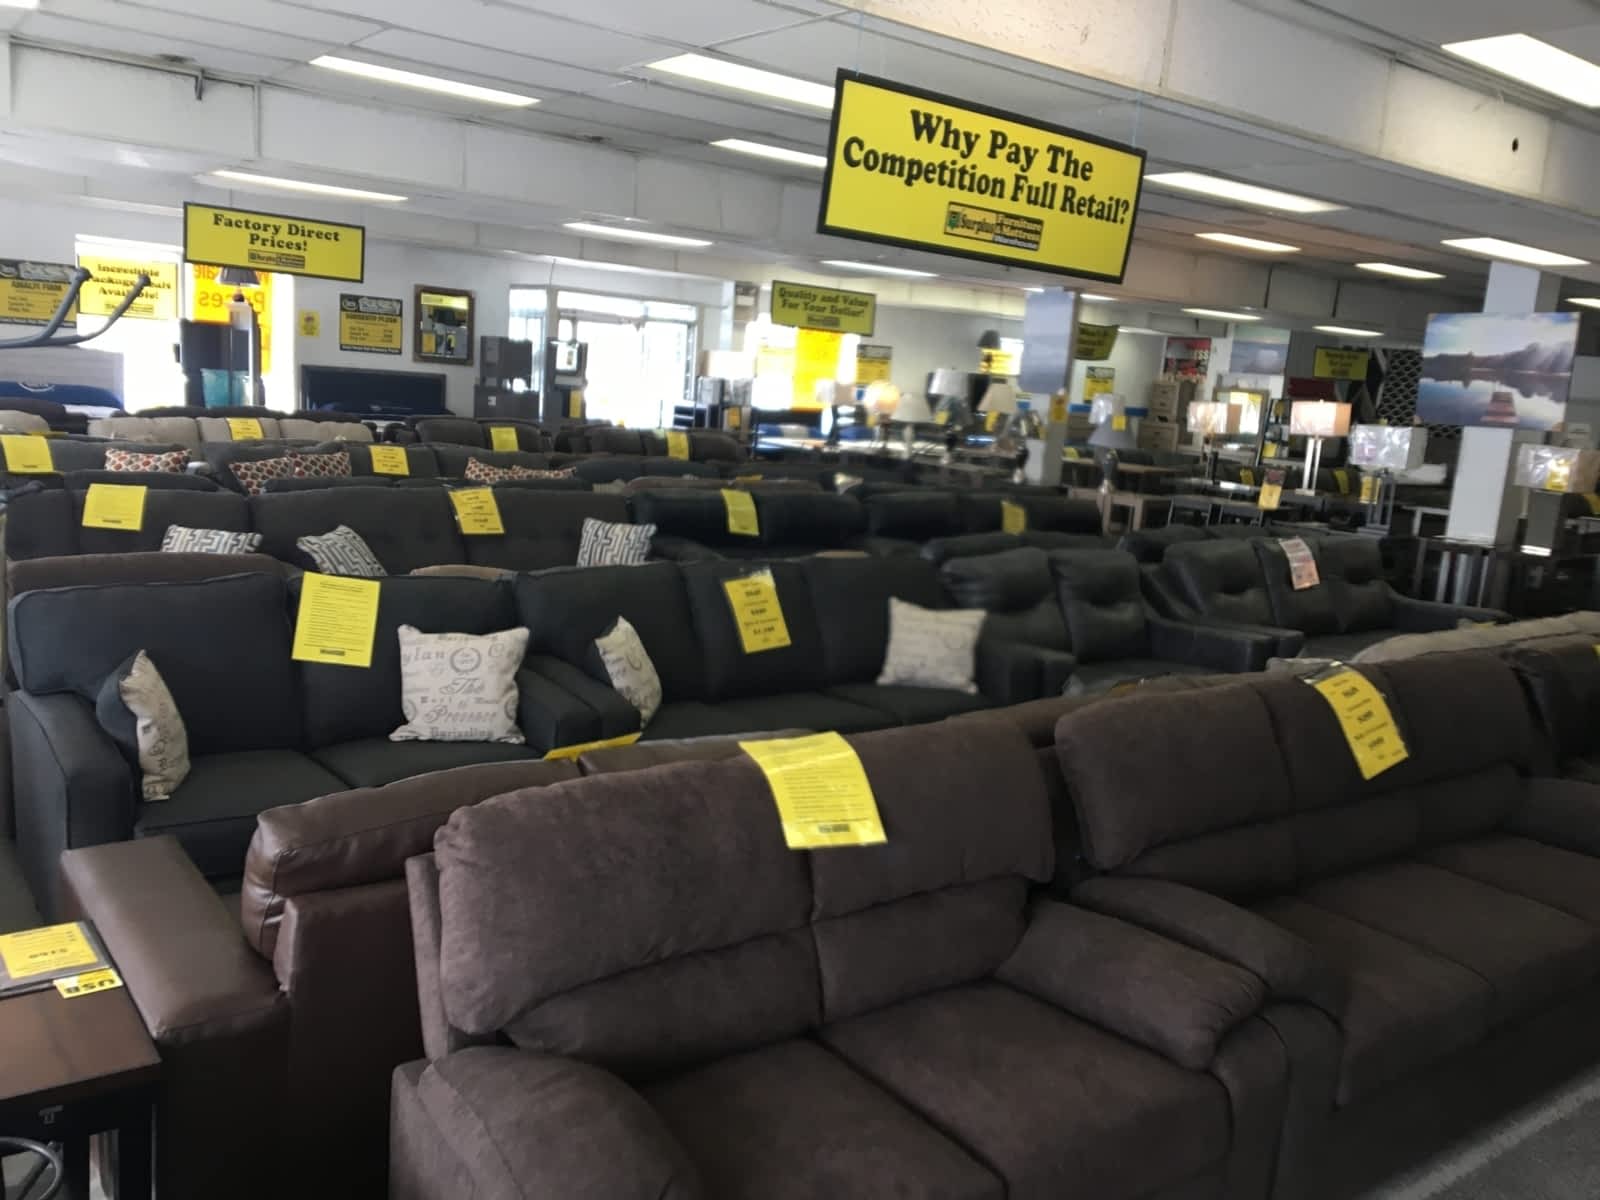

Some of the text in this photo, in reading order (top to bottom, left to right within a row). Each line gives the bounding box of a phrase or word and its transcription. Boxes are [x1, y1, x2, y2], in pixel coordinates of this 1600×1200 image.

[910, 109, 1093, 181] Why Pay The
[843, 136, 1130, 224] Competition Full Retail?
[212, 213, 341, 242] Factory Direct
[249, 233, 308, 251] Prices!
[779, 287, 869, 307] Quality and Value
[782, 298, 799, 309] For
[64, 978, 116, 994] USB
